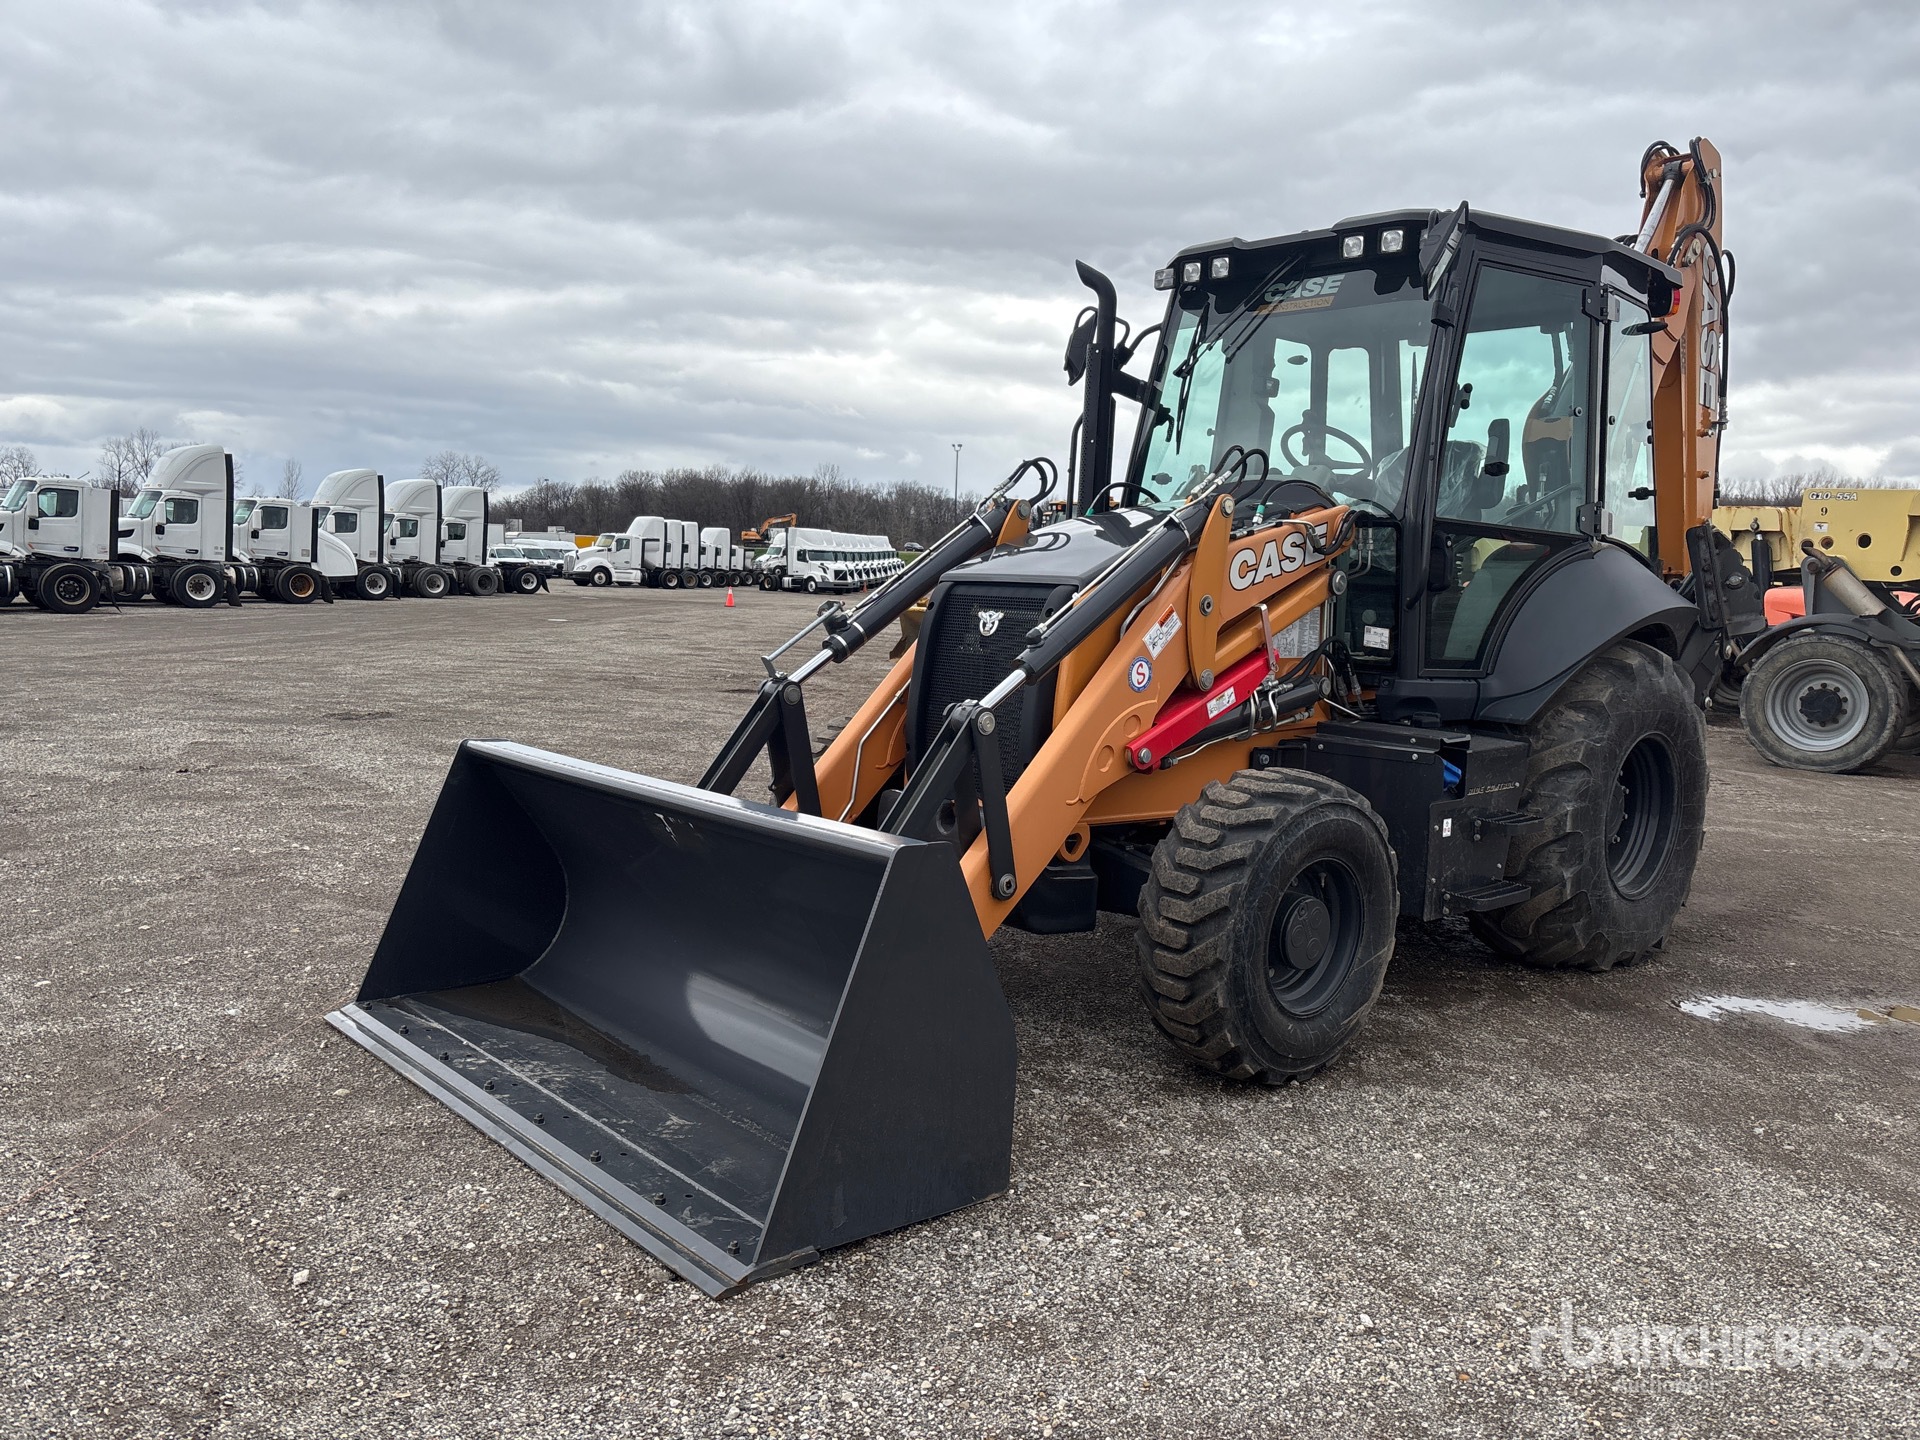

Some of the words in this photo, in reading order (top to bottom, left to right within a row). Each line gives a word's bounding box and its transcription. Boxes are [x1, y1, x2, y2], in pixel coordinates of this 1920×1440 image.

[1264, 274, 1346, 302] CASE
[1268, 298, 1332, 313] ONSTRUCTION
[1699, 242, 1719, 411] CASE
[1809, 491, 1858, 501] G10-55A
[1820, 506, 1828, 517] 9
[1229, 522, 1328, 591] CASE
